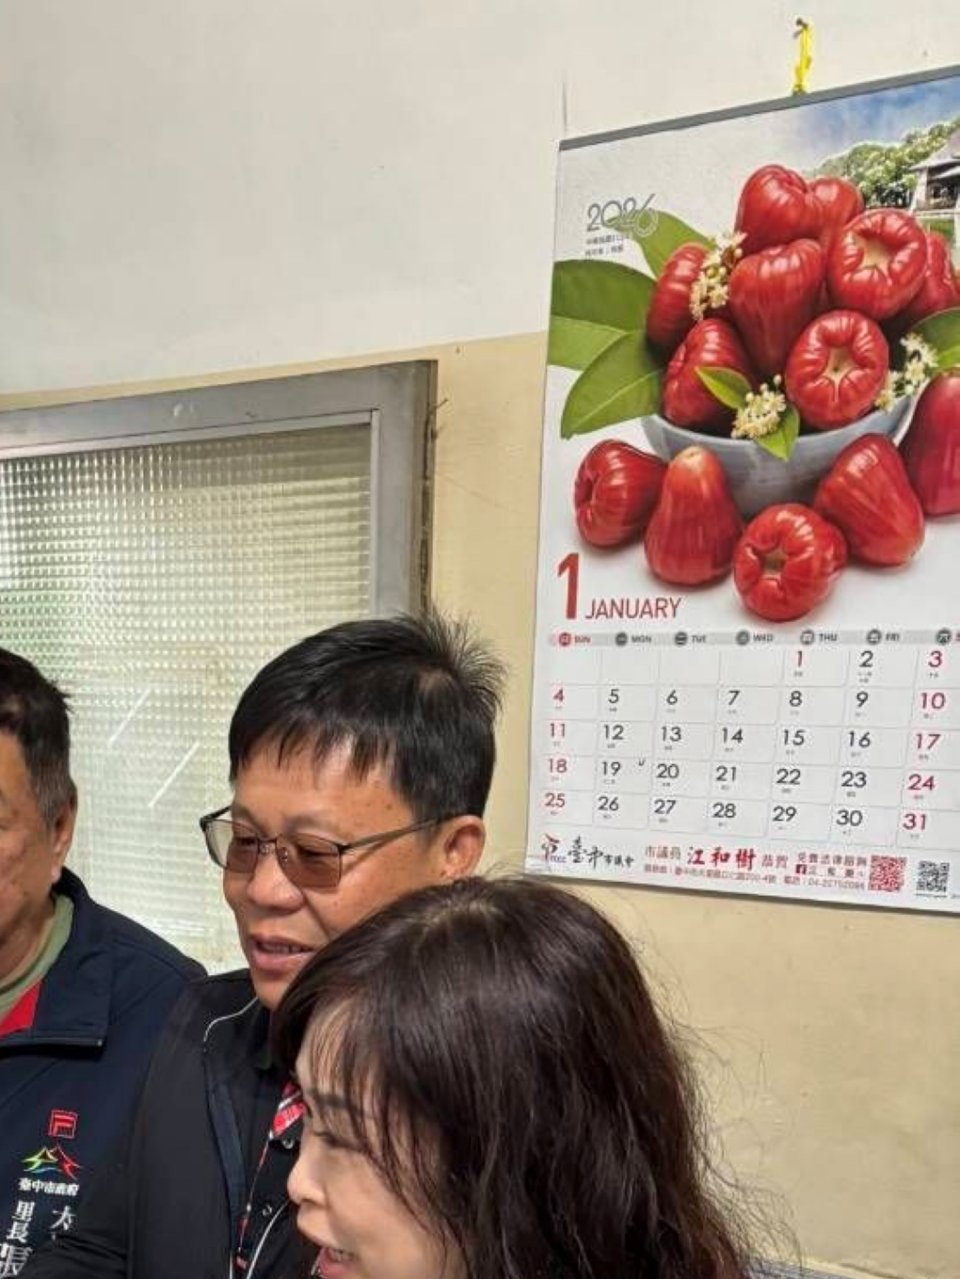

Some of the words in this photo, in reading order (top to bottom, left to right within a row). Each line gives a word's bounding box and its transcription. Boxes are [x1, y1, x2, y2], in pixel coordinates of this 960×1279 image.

[587, 193, 659, 237] 2026
[558, 550, 583, 619] 1
[585, 597, 682, 619] JANUARY
[691, 634, 707, 645] TUE
[818, 633, 838, 643] THU
[885, 632, 900, 642] FRI
[798, 651, 802, 667] 1
[860, 651, 873, 667] 2
[928, 651, 942, 667] 3
[554, 689, 563, 702] 4
[608, 689, 619, 703] 5
[667, 690, 678, 705] 6
[729, 690, 740, 705] 7
[789, 691, 802, 707] 8
[856, 691, 868, 707] 9
[922, 693, 946, 709] 10
[550, 723, 565, 737] 11
[604, 725, 624, 740] 12
[662, 726, 681, 741] 13
[723, 728, 743, 743] 14
[784, 729, 804, 746] 15
[849, 731, 871, 748] 16
[917, 733, 941, 750] 17
[549, 759, 567, 773] 18
[603, 761, 621, 776] 19
[657, 764, 679, 778] 20
[716, 766, 736, 781] 21
[777, 768, 800, 785] 22
[841, 771, 866, 788] 23
[908, 774, 934, 790] 24
[545, 793, 565, 807] 25
[598, 796, 619, 811] 26
[654, 799, 676, 814] 27
[713, 803, 736, 818] 28
[773, 806, 797, 821] 29
[836, 809, 863, 826] 30
[903, 814, 926, 830] 31
[645, 846, 681, 859] 市議員
[687, 846, 755, 870] 江和樹
